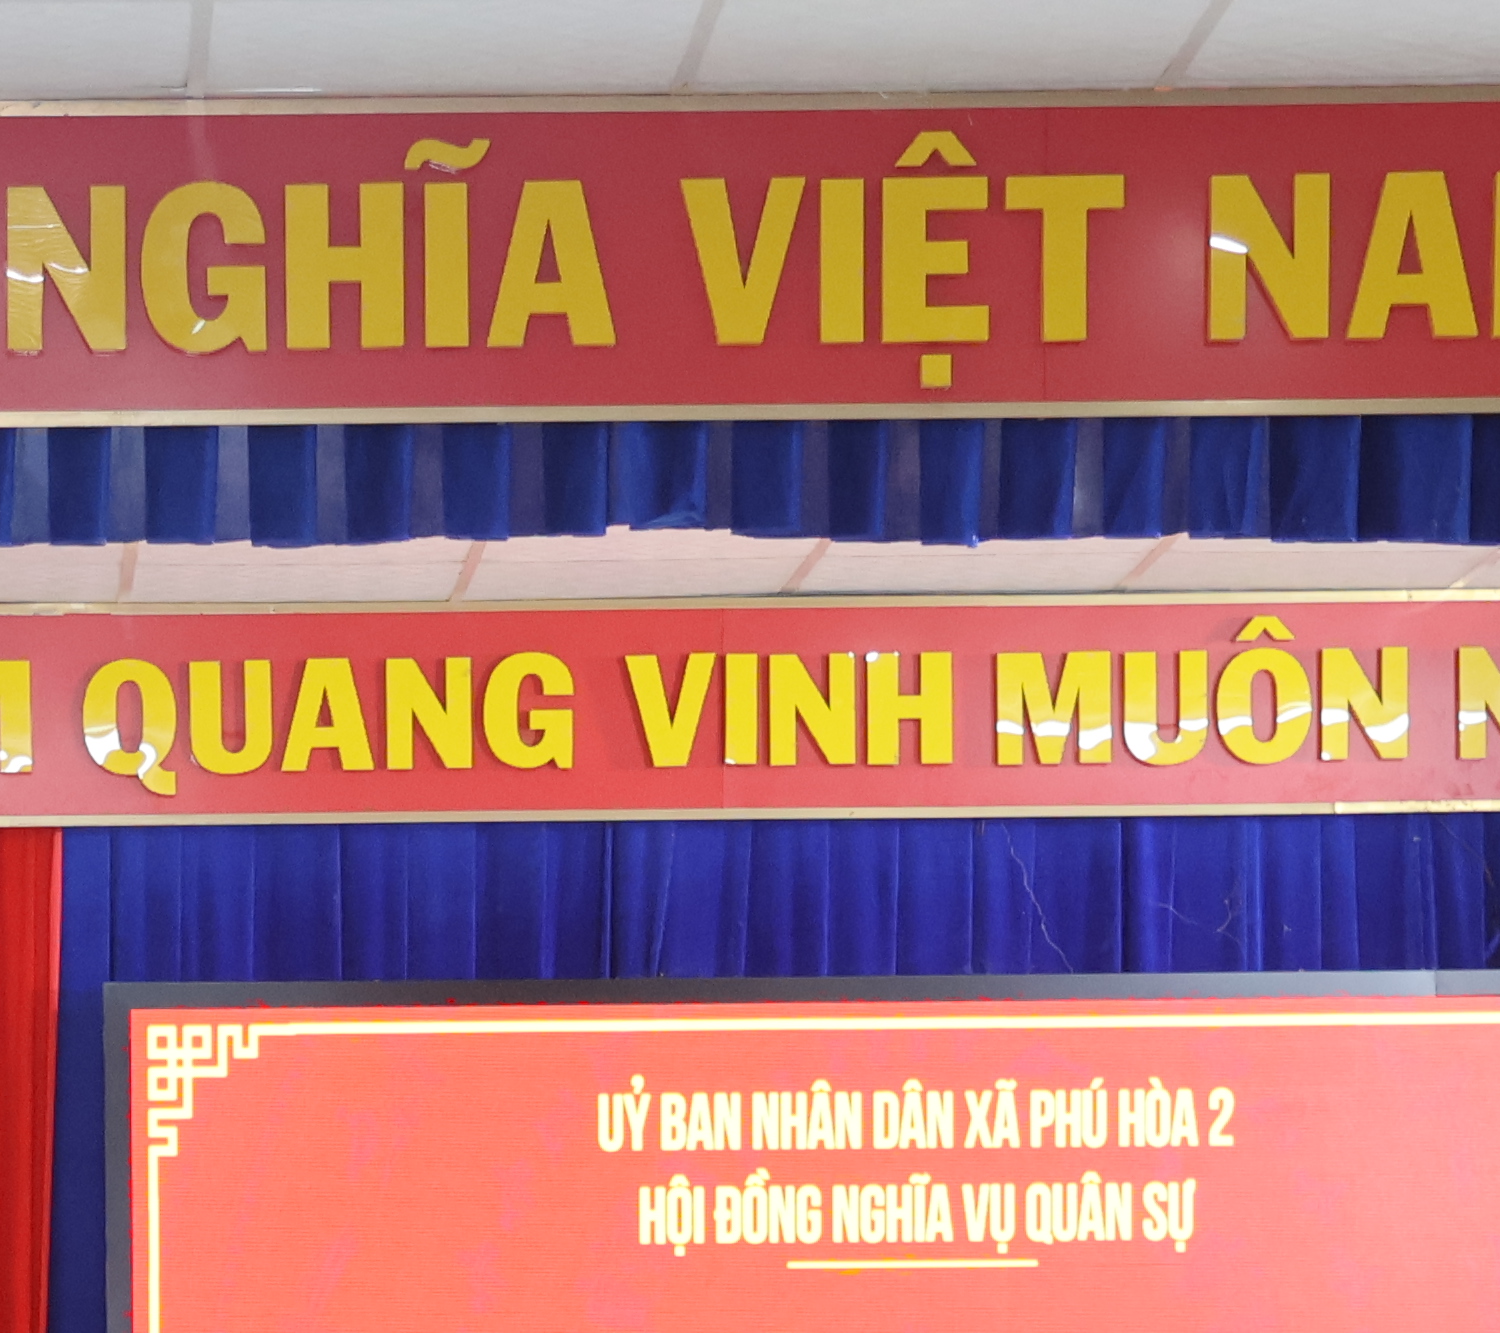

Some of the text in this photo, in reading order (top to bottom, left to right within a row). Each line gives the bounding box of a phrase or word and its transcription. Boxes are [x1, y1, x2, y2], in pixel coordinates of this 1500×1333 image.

[7, 138, 616, 353] NGHĨA
[680, 129, 1126, 388] VIỆT
[81, 650, 576, 797] QUANG
[623, 649, 956, 768] VINH
[995, 613, 1410, 767] MUÔN
[659, 1091, 743, 1152] BAN
[751, 1078, 864, 1151] NHÂN
[872, 1078, 955, 1150] DÂN
[963, 1078, 1021, 1149] XÃ
[1029, 1076, 1109, 1149] PHÚ
[1117, 1075, 1200, 1148] HÒA
[1207, 1085, 1237, 1147] 2
[638, 1166, 1198, 1258] HỘI ĐỒNG NGHĨA VỤ QUÂN SỰ
